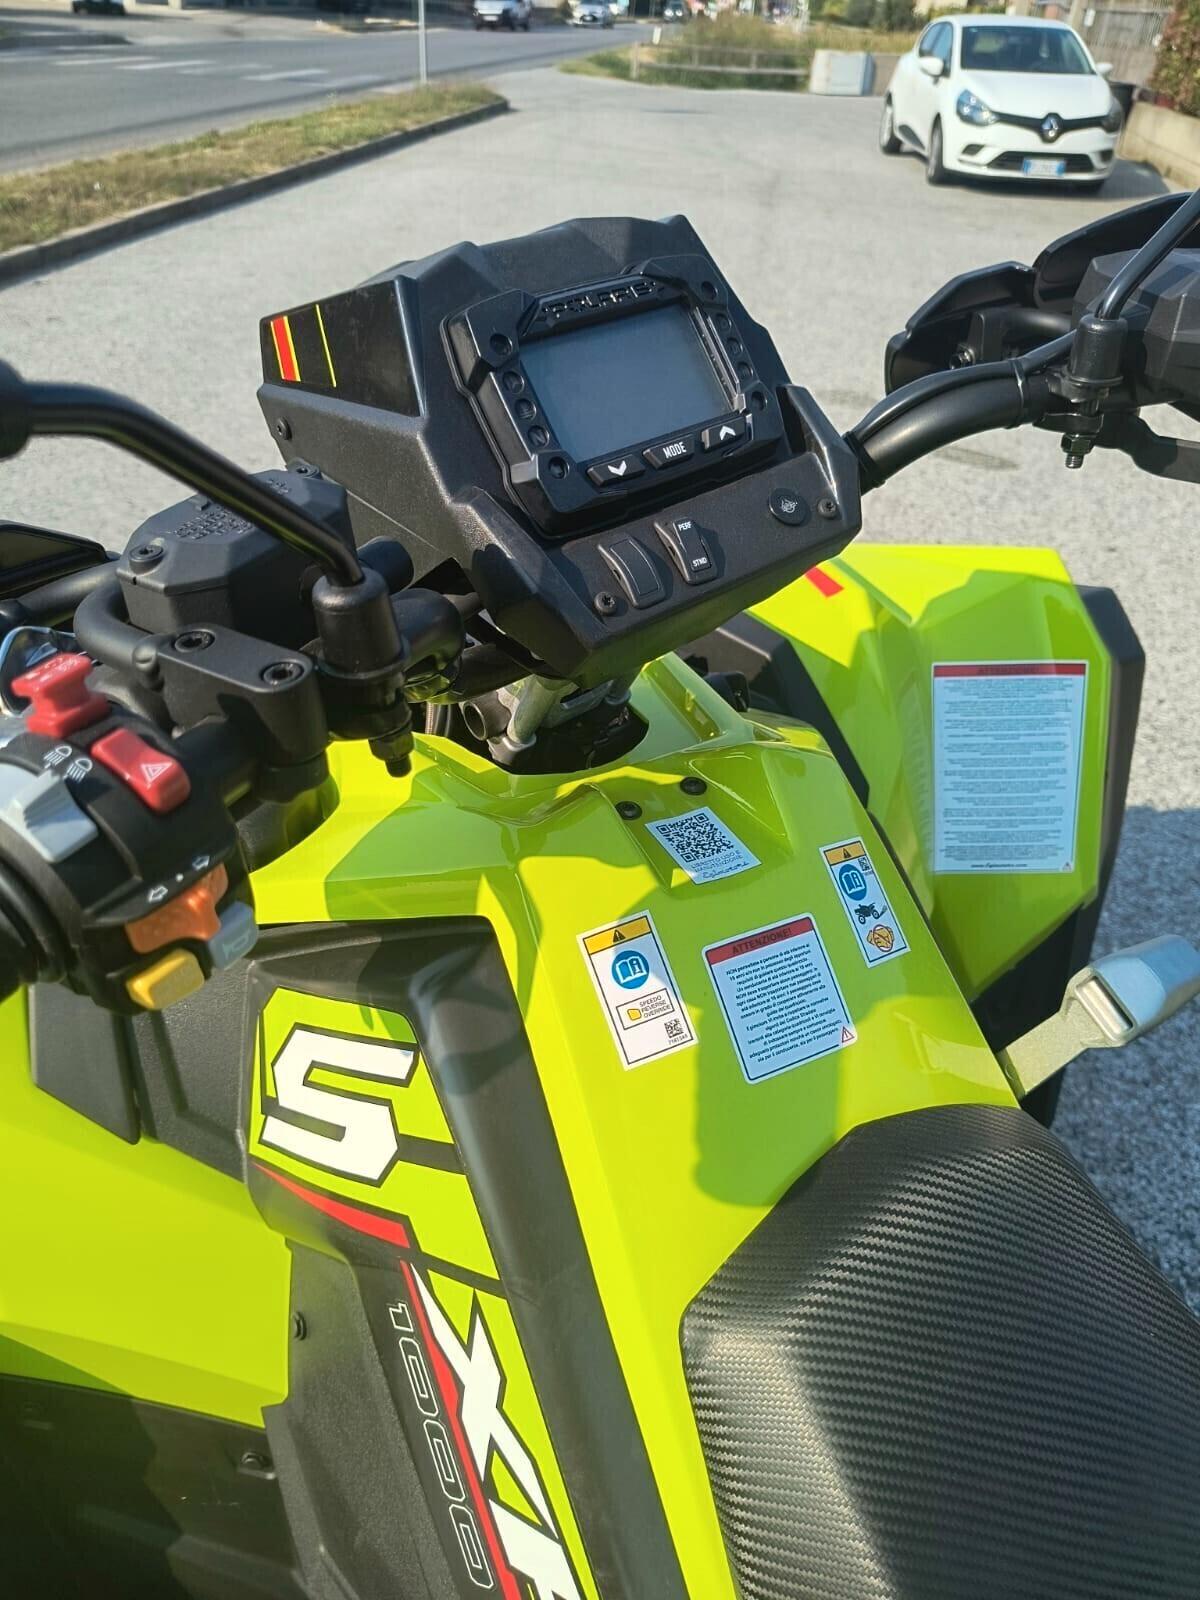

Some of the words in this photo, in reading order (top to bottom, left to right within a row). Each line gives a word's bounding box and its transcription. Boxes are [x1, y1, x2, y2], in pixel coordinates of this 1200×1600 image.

[662, 441, 687, 459] MODE
[677, 521, 692, 532] PERF
[692, 556, 708, 567] STND
[731, 927, 792, 954] ATTENZIONE!
[639, 994, 662, 1007] SPEEDO
[643, 1004, 671, 1018] OVERRIDE
[260, 1025, 417, 1185] S
[388, 1302, 494, 1589] 1000
